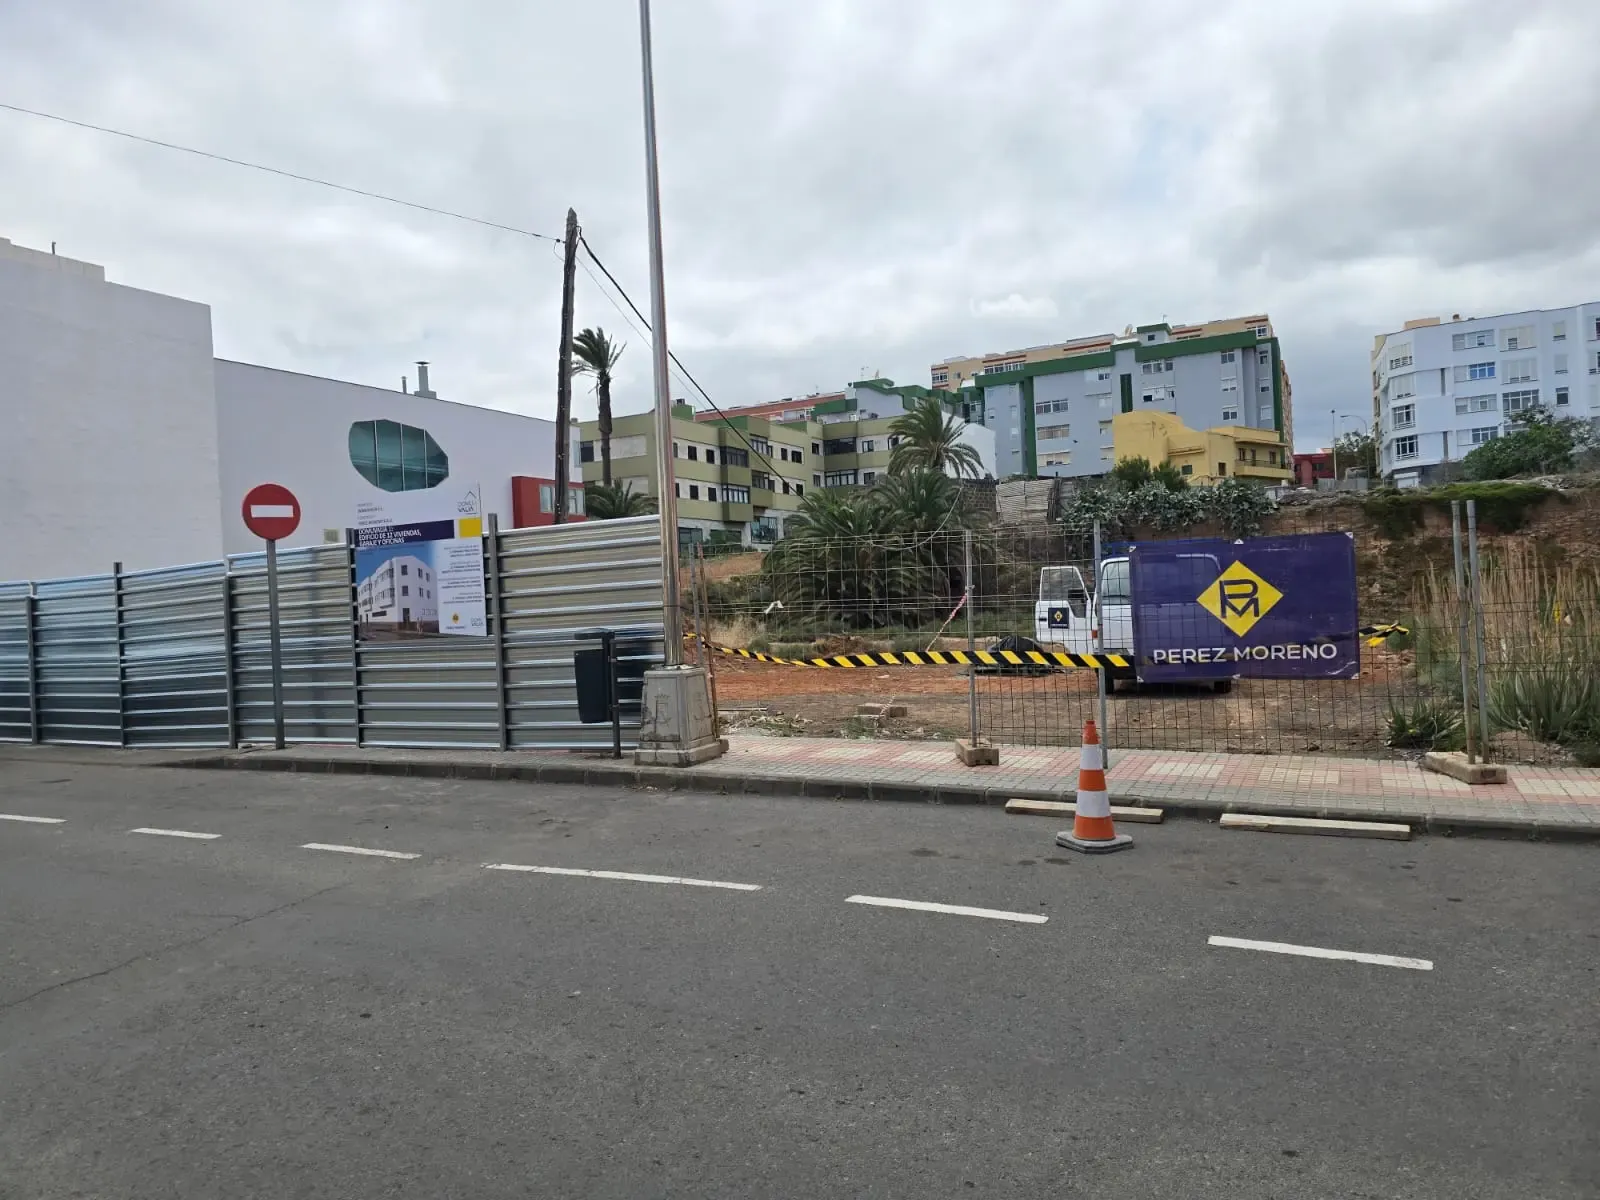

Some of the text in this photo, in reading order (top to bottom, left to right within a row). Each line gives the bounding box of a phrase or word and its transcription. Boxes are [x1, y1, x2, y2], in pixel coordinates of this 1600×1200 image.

[359, 533, 379, 541] EDIFICIO
[1153, 643, 1338, 664] PEREZ MORENO
